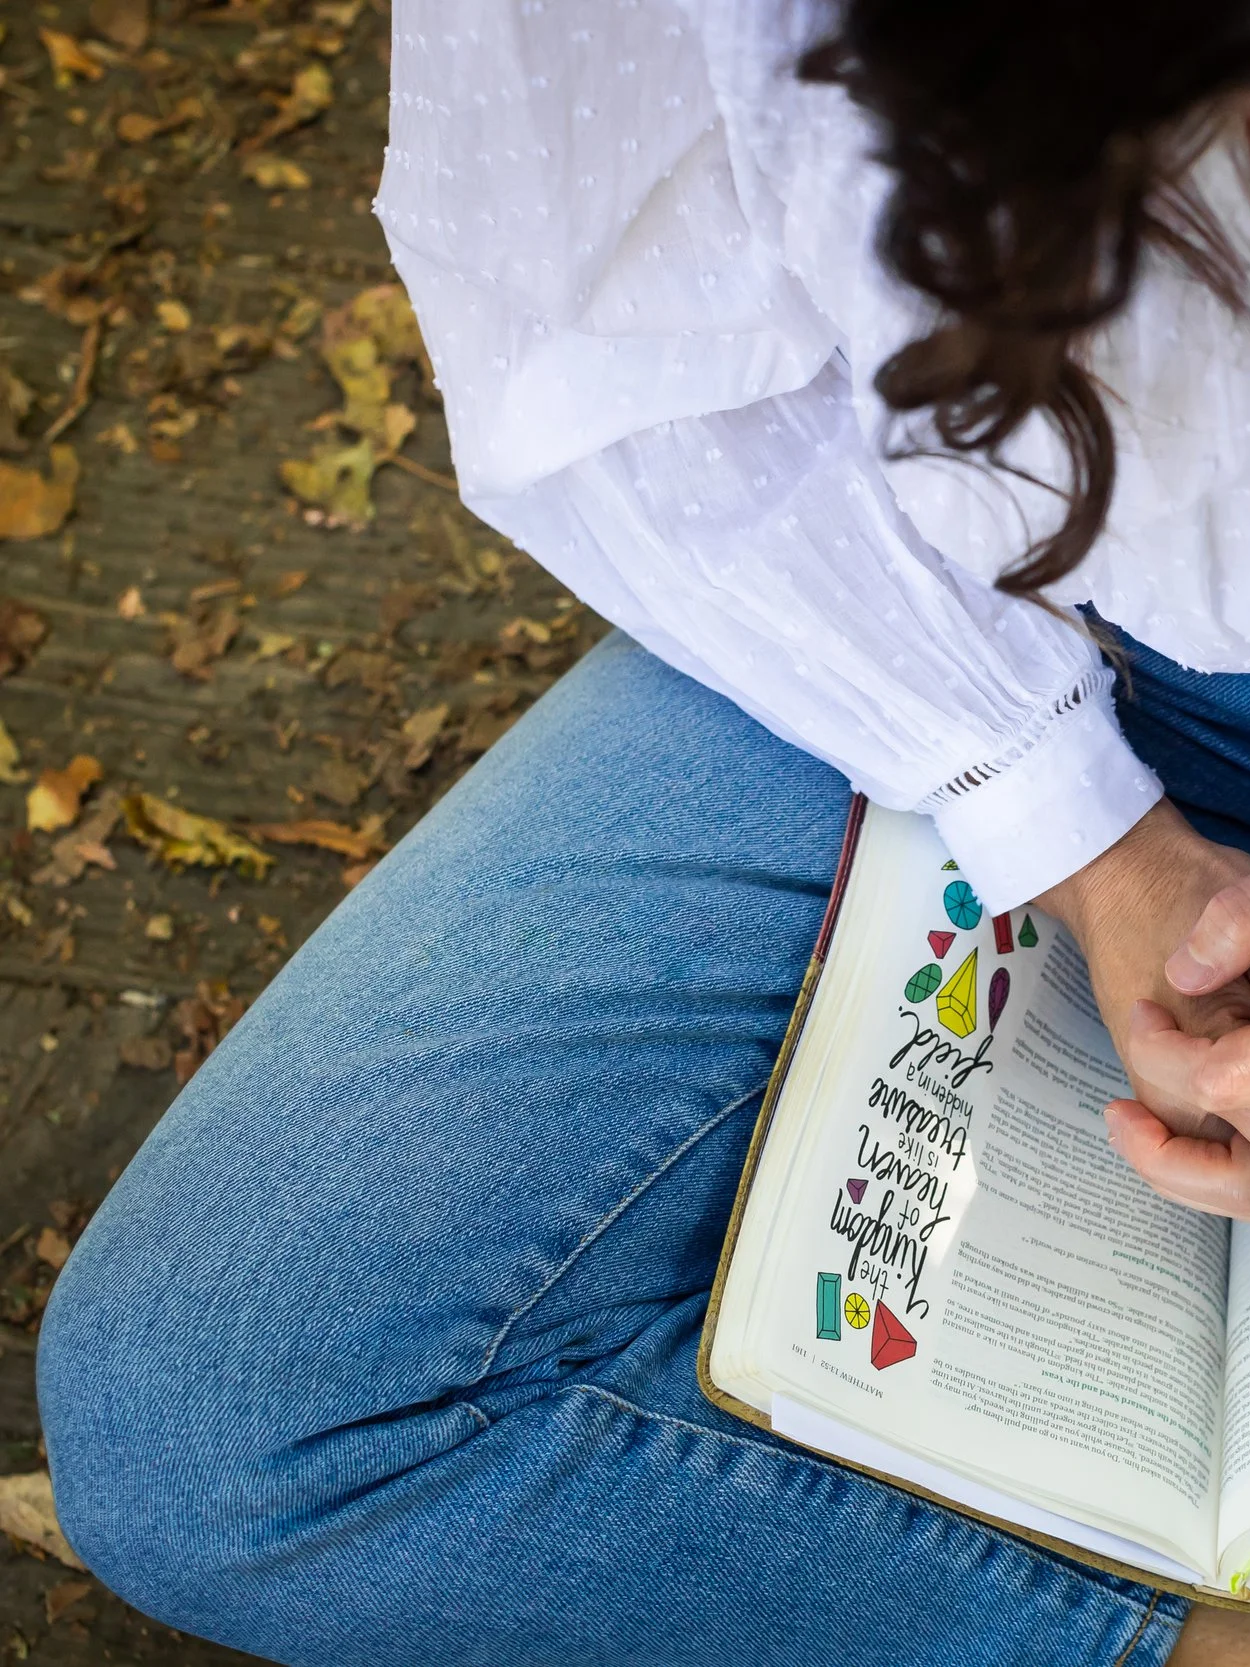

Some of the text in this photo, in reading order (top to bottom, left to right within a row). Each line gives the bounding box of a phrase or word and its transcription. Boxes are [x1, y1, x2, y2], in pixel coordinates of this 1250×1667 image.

[889, 1006, 993, 1089] field.
[906, 1062, 973, 1128] hidden in a
[868, 1078, 966, 1170] treasure
[898, 1132, 938, 1172] is like
[858, 1125, 950, 1242] heaven
[898, 1200, 920, 1230] of
[830, 1188, 929, 1319] kingdom
[860, 1260, 888, 1300] the
[942, 1317, 975, 1336] mustard
[982, 1335, 998, 1347] like
[999, 1341, 1006, 1350] is
[1007, 1344, 1036, 1362] heaven
[792, 1344, 884, 1399] MATTHEW 13:52 1161
[931, 1367, 950, 1380] time
[1047, 1359, 1083, 1377] kingdom
[950, 1375, 966, 1387] that
[966, 1381, 976, 1391] At
[943, 1382, 961, 1395] may
[933, 1358, 1138, 1439] First collect the weeds and tie them in bundles to be
[962, 1390, 978, 1401] you
[1041, 1370, 1169, 1423] the Mustard Seed and the Yeast
[1008, 1398, 1022, 1408] the
[1021, 1403, 1042, 1414] until
[982, 1409, 1004, 1422] them
[1005, 1407, 1019, 1418] the
[1019, 1411, 1050, 1427] pulling
[1042, 1410, 1076, 1426] together
[1004, 1417, 1022, 1428] pull
[1021, 1423, 1038, 1433] and
[1050, 1422, 1064, 1432] are
[1076, 1421, 1097, 1432] grow
[1038, 1429, 1050, 1437] go
[1049, 1432, 1058, 1441] to
[1064, 1427, 1080, 1437] you
[1080, 1432, 1102, 1445] while
[1097, 1427, 1116, 1441] both
[1059, 1436, 1069, 1444] us
[1070, 1439, 1090, 1451] want
[1091, 1446, 1106, 1457] you
